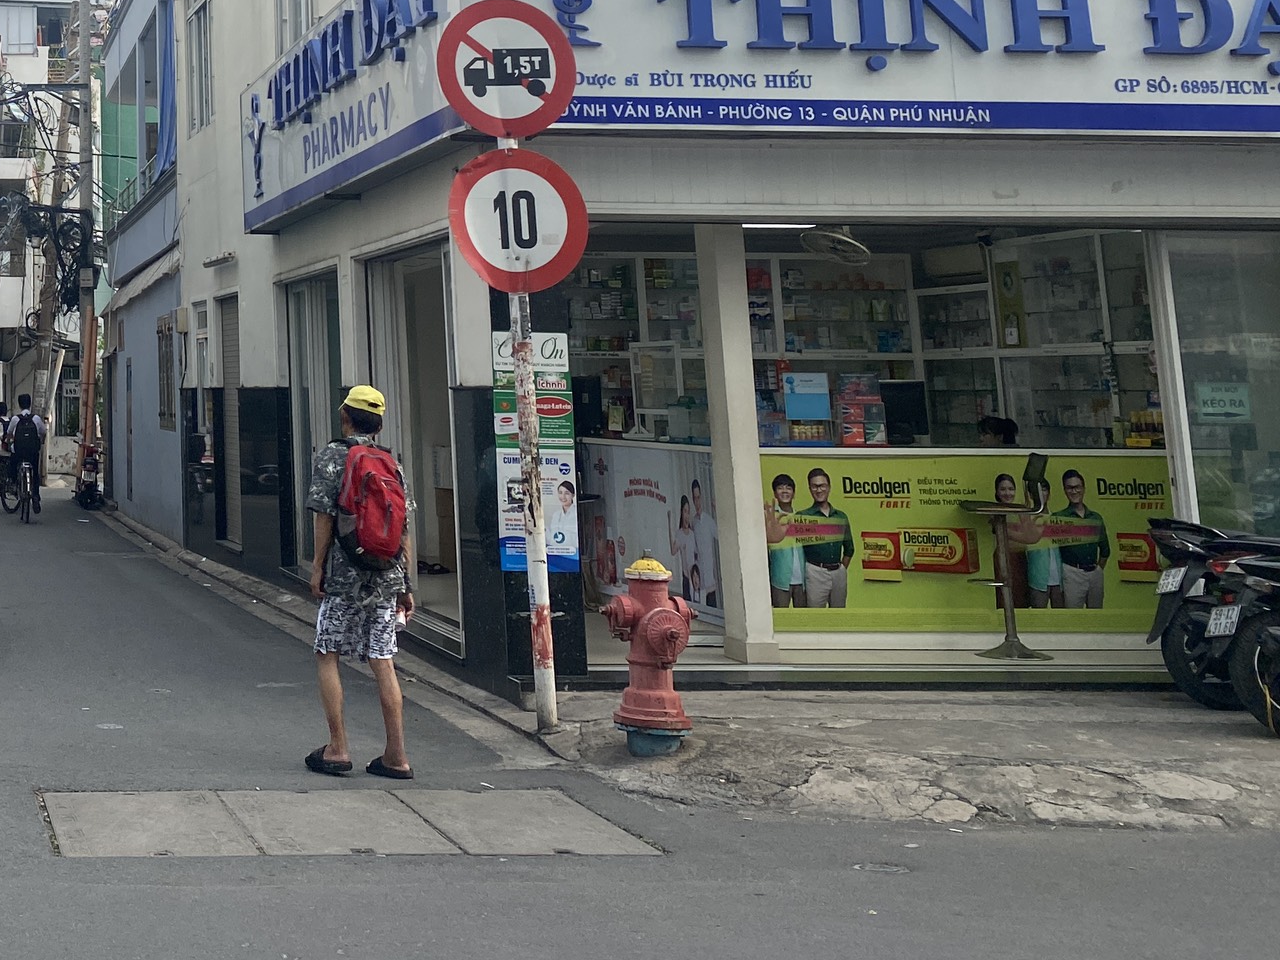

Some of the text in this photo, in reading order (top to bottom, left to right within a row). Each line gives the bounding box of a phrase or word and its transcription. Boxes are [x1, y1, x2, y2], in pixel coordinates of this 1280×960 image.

[267, 9, 357, 130] THỊNH
[503, 56, 542, 77] 1,5T
[625, 72, 639, 87] sĩ
[649, 70, 684, 87] BÙI
[690, 73, 757, 91] TRỌNG
[764, 69, 812, 89] HIẾU
[1114, 78, 1141, 93] GP
[561, 99, 607, 118] UỲNH
[612, 101, 651, 118] VĂN
[655, 102, 702, 119] BÁNH
[719, 103, 792, 120] PHƯỜNG
[798, 107, 815, 121] 13
[833, 104, 885, 124] QUẬN
[890, 104, 923, 122] PHÚ
[929, 105, 991, 125] NHUẬN
[302, 82, 391, 174] PHARMACY
[493, 190, 538, 250] 10
[1202, 398, 1246, 409] KÉO RA
[842, 477, 911, 498] Decolgen
[1096, 478, 1165, 500] Decolgen
[880, 500, 911, 509] FORTE
[1135, 502, 1166, 510] FORTE
[904, 531, 950, 547] Decolgen
